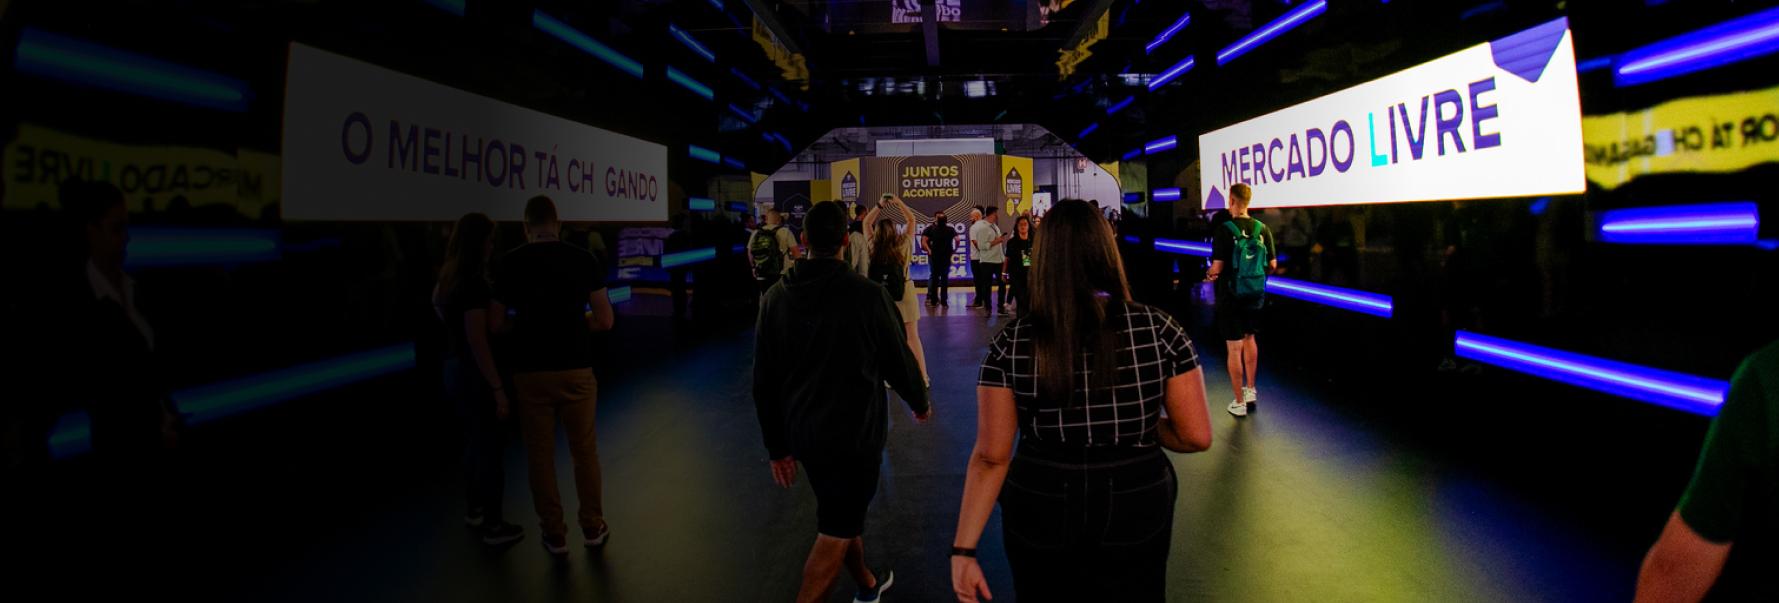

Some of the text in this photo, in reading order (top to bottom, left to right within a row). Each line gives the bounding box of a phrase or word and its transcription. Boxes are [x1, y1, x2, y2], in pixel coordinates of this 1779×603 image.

[1221, 120, 1355, 189] MERCADO
[1368, 76, 1501, 167] LIVRE
[341, 111, 373, 165] O
[388, 119, 526, 191] MELHOR
[534, 144, 561, 190] TÁ
[902, 165, 959, 177] JUNTOS
[902, 178, 960, 188] O FUTURO
[902, 188, 960, 198] ACONTECE
